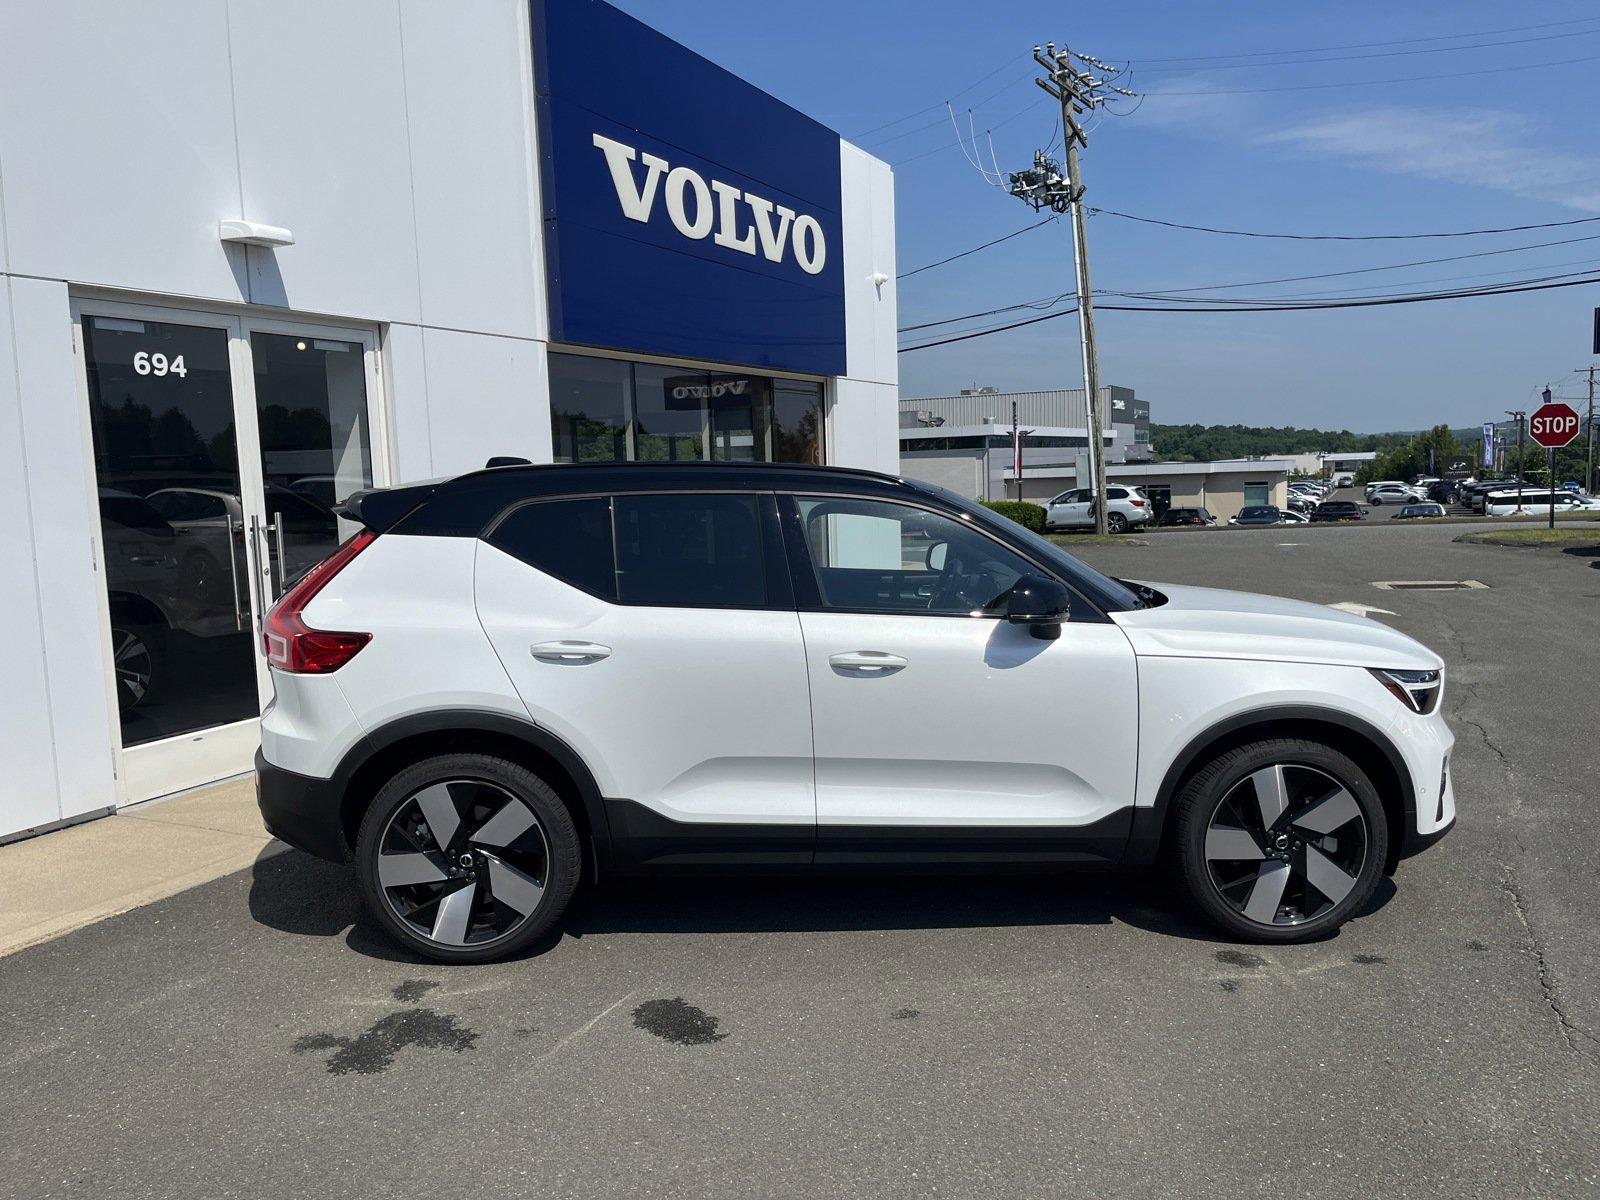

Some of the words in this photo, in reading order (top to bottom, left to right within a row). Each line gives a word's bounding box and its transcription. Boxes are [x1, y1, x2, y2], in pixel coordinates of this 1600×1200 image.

[593, 133, 826, 275] VOLVO
[133, 351, 187, 378] 694
[1532, 416, 1576, 434] STOP
